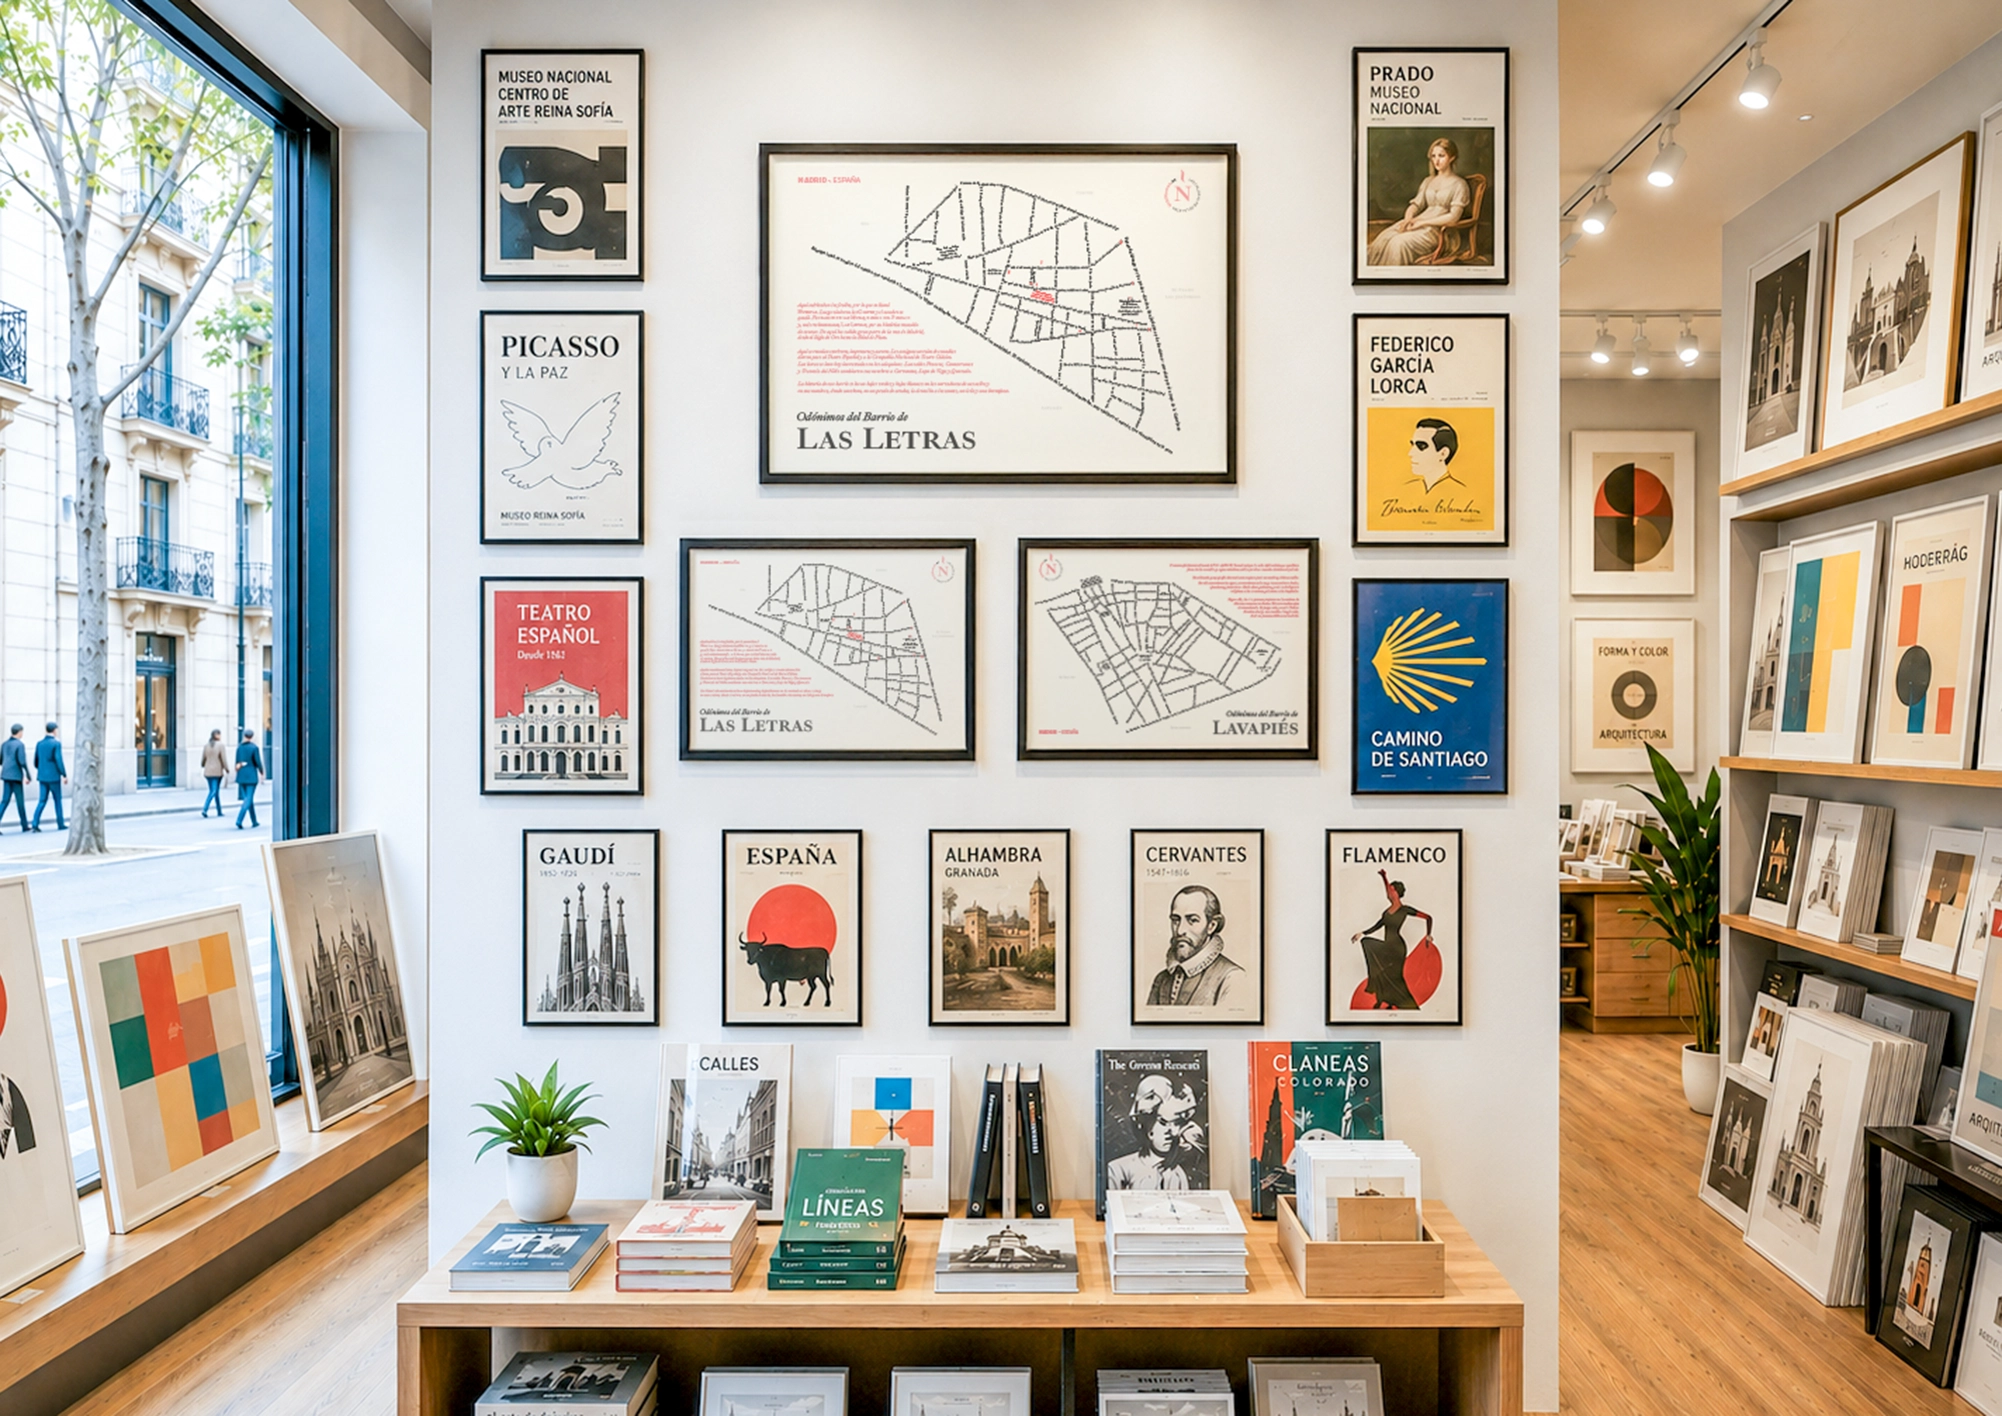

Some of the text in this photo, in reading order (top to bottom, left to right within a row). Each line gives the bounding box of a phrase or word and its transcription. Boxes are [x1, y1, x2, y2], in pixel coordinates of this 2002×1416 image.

[498, 70, 612, 83] MUSEO NACIONAL
[1370, 66, 1434, 81] PRADO
[498, 87, 569, 101] CENTRO DE
[1370, 86, 1420, 99] MUSEO
[498, 101, 613, 118] ARTE REINA SOFÍA
[1370, 102, 1442, 115] NACIONAL
[797, 176, 828, 184] MADRID
[1174, 185, 1192, 202] N
[501, 335, 620, 358] PICASSO
[1371, 336, 1454, 352] FEDERICO
[1370, 353, 1435, 373] GARCÍA
[501, 366, 568, 379] Y LA PAZ
[1371, 378, 1427, 394] LORCA
[846, 411, 862, 422] del
[862, 411, 896, 422] Barrio
[897, 411, 909, 422] de
[517, 604, 591, 621] TEATRO
[518, 623, 600, 644] ESPAÑOL
[1598, 646, 1669, 657] FORMA Y COLOR
[1213, 717, 1299, 735] LAVAPIÉS
[1371, 730, 1443, 747] CAMINO
[1599, 729, 1667, 742] ARQUITECTURA
[1372, 751, 1488, 767] DE SANTIAGO
[540, 842, 615, 865] GAUDÍ
[746, 843, 837, 865] ESPAÑA
[945, 847, 1042, 862] ALHAMBRA
[1146, 846, 1247, 862] CERVANTES
[1343, 847, 1446, 863] FLAMENCO
[945, 867, 999, 878] GRANADA
[699, 1056, 759, 1071] CALLES
[1107, 1059, 1127, 1070] The
[1273, 1054, 1369, 1072] CLANEAS
[1278, 1077, 1369, 1087] COLORADO
[802, 1194, 884, 1217] LÍNEAS
